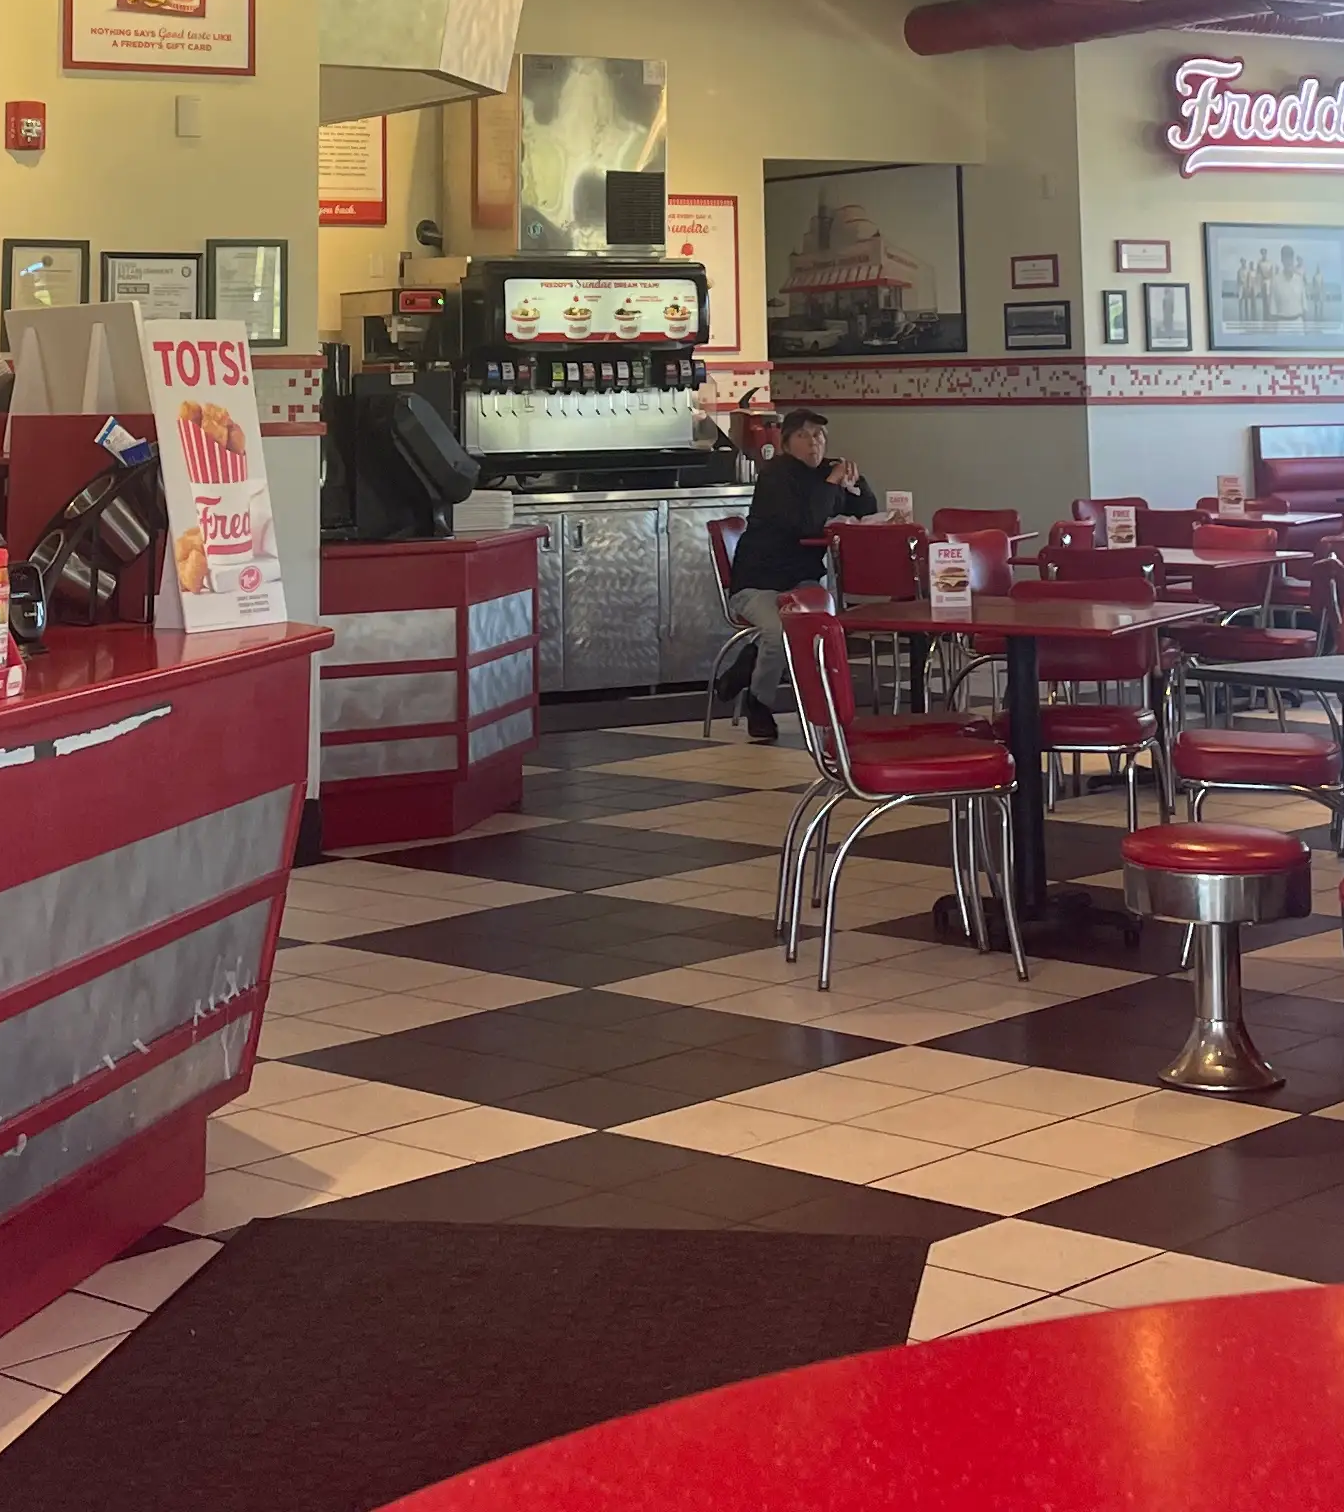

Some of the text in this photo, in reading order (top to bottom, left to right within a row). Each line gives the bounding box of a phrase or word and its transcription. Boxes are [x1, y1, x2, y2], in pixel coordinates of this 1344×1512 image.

[90, 27, 131, 37] NOTHING
[134, 30, 156, 38] SAYS
[158, 28, 184, 41] Good
[213, 34, 232, 42] LIKE
[112, 40, 212, 52] A FREDDY'S GIFT CARD
[668, 220, 709, 234] undae
[575, 279, 612, 289] Sundae
[153, 341, 249, 387] TOTS!
[938, 548, 963, 559] FREE
